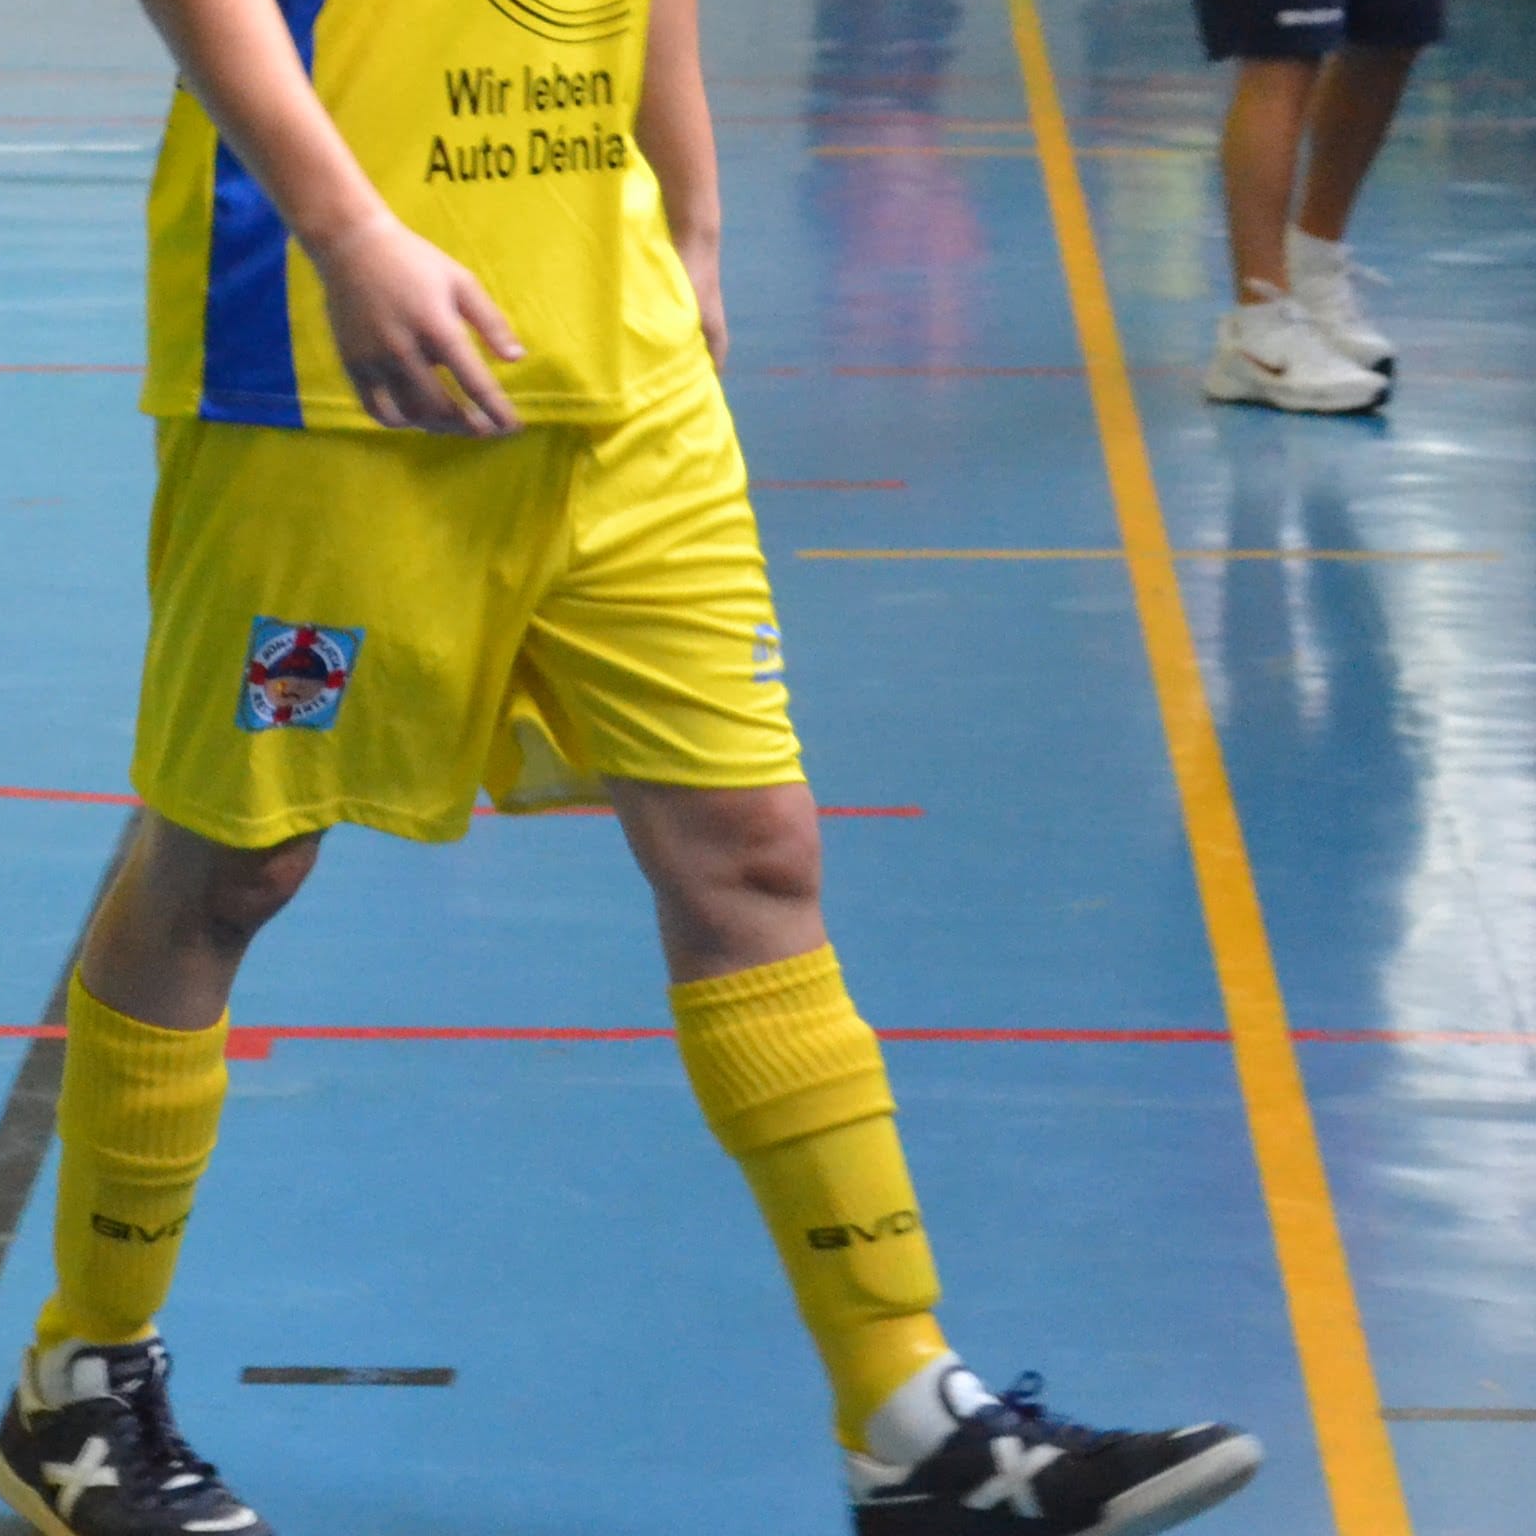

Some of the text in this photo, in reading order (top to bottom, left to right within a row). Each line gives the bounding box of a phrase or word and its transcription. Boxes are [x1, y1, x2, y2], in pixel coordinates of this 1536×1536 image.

[444, 62, 614, 117] Wir leben
[424, 122, 628, 184] Auto Dénia
